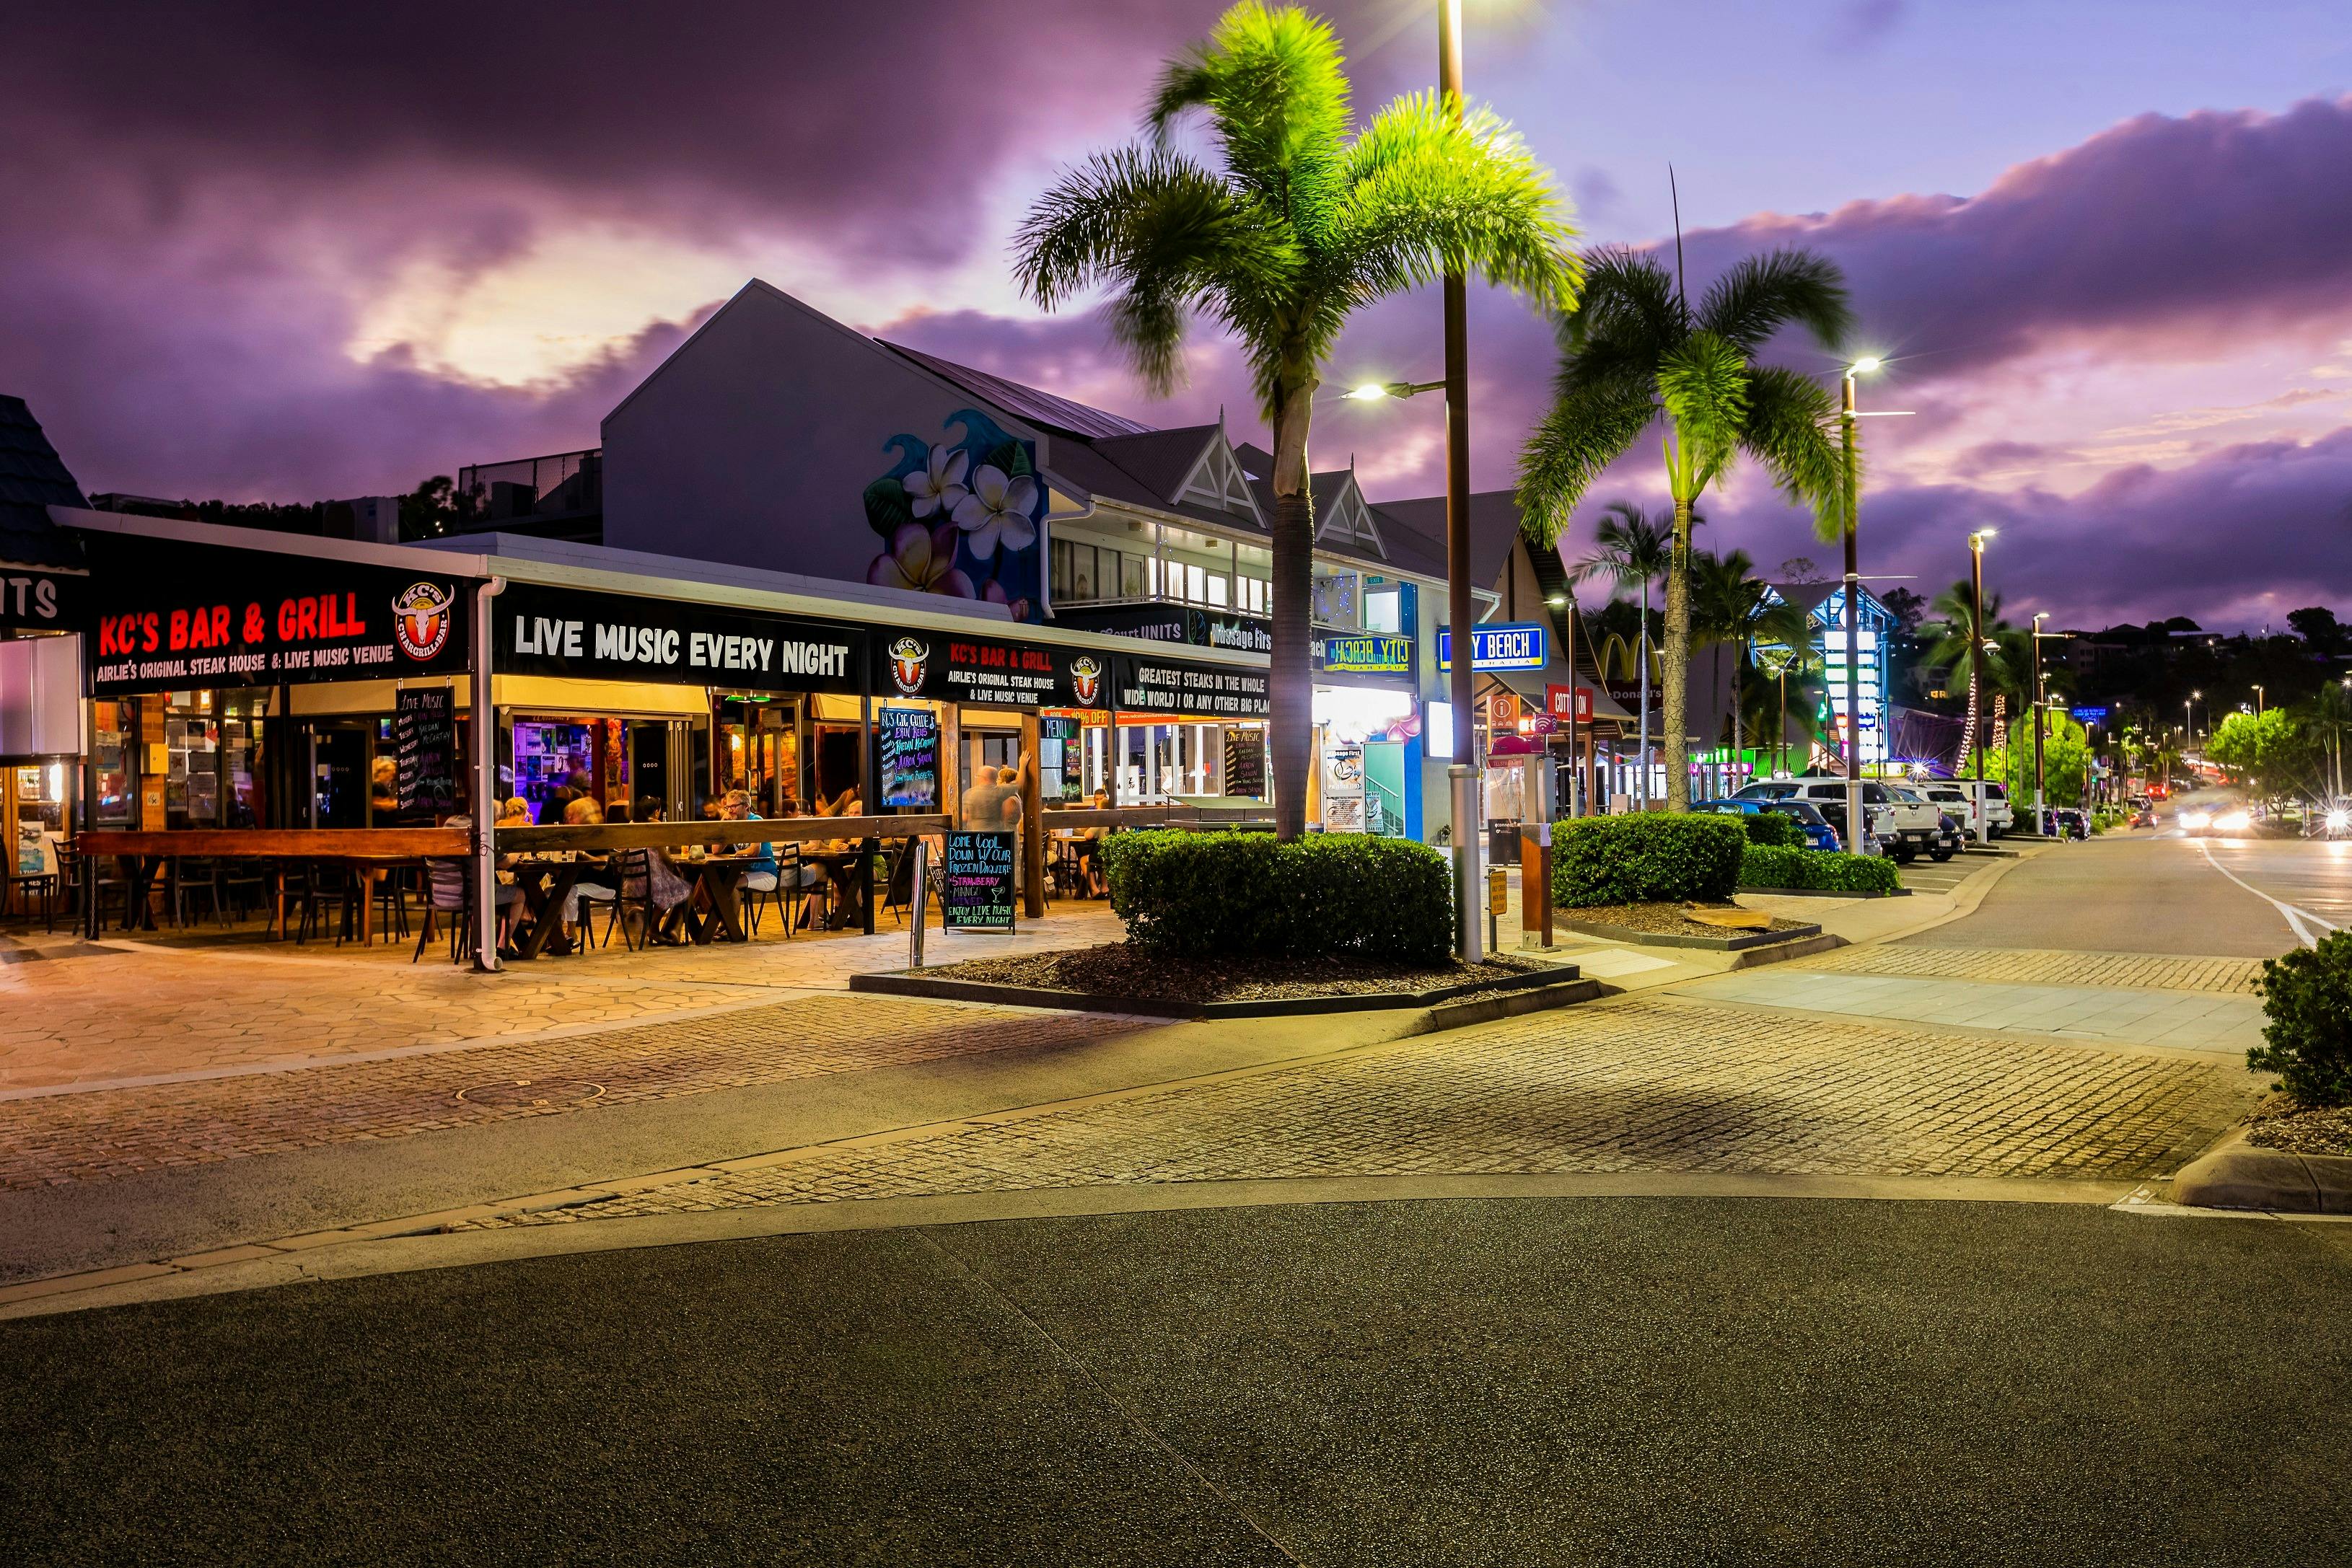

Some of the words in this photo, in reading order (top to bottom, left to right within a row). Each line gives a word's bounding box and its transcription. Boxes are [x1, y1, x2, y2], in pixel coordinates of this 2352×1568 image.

[403, 585, 442, 607] KC'S
[100, 612, 159, 657] KC'S
[170, 604, 231, 651] BAR
[242, 602, 265, 643] &
[278, 592, 366, 642] GRILL
[1141, 622, 1182, 640] UNITS
[1211, 622, 1253, 650] Massage
[1255, 627, 1272, 651] Firs
[515, 615, 584, 657] LIVE
[595, 623, 680, 664] MUSIC
[690, 632, 774, 671] EVERY
[782, 640, 849, 677] NIGHT
[896, 640, 921, 655] KC'S
[1487, 633, 1530, 659] BEACH
[97, 659, 137, 682] AIRLIE'S
[140, 659, 188, 679] ORIGINAL
[190, 656, 226, 674] STEAK
[229, 653, 266, 672] HOUSE
[271, 653, 280, 668] &
[284, 651, 310, 669] LIVE
[313, 648, 349, 667] MUSIC
[353, 644, 394, 664] VENUE
[950, 643, 977, 664] KC'S
[980, 648, 1006, 667] BAR
[1010, 651, 1018, 668] &
[1022, 652, 1053, 671] GRILL
[947, 670, 976, 684] AIRLIE'S
[978, 672, 1009, 687] ORIGINAL
[1010, 676, 1032, 689] STEAK
[1033, 677, 1054, 690] HOUSE
[1138, 667, 1181, 686] GREATEST
[1183, 671, 1214, 689] STEAKS
[1215, 675, 1223, 690] IN
[1224, 676, 1239, 691] THE
[1240, 677, 1265, 693] WHOLE
[400, 695, 419, 710] LIVE
[422, 693, 444, 709] MUSIC
[970, 689, 975, 700] &
[977, 689, 993, 701] LIVE
[994, 690, 1015, 702] MUSIC
[1017, 691, 1038, 704] VENUE
[1123, 689, 1146, 705] WIDE
[1147, 690, 1175, 708] WORLD
[1183, 693, 1194, 708] OR
[1196, 694, 1212, 710] ANY
[1214, 696, 1239, 712] OTHER
[1240, 697, 1252, 713] BIG
[1579, 695, 1587, 715] ON
[910, 713, 929, 728] GUIDE
[1091, 710, 1108, 724] OFF
[1046, 719, 1068, 739] MENU
[1241, 731, 1260, 742] MUSIC
[949, 833, 971, 847] COME
[949, 847, 974, 860] DOWN
[949, 860, 979, 875] FROZEN
[953, 886, 981, 897] MANGO
[952, 897, 983, 905] MIXED
[948, 906, 970, 916] ENJOY
[973, 905, 991, 916] LIVE
